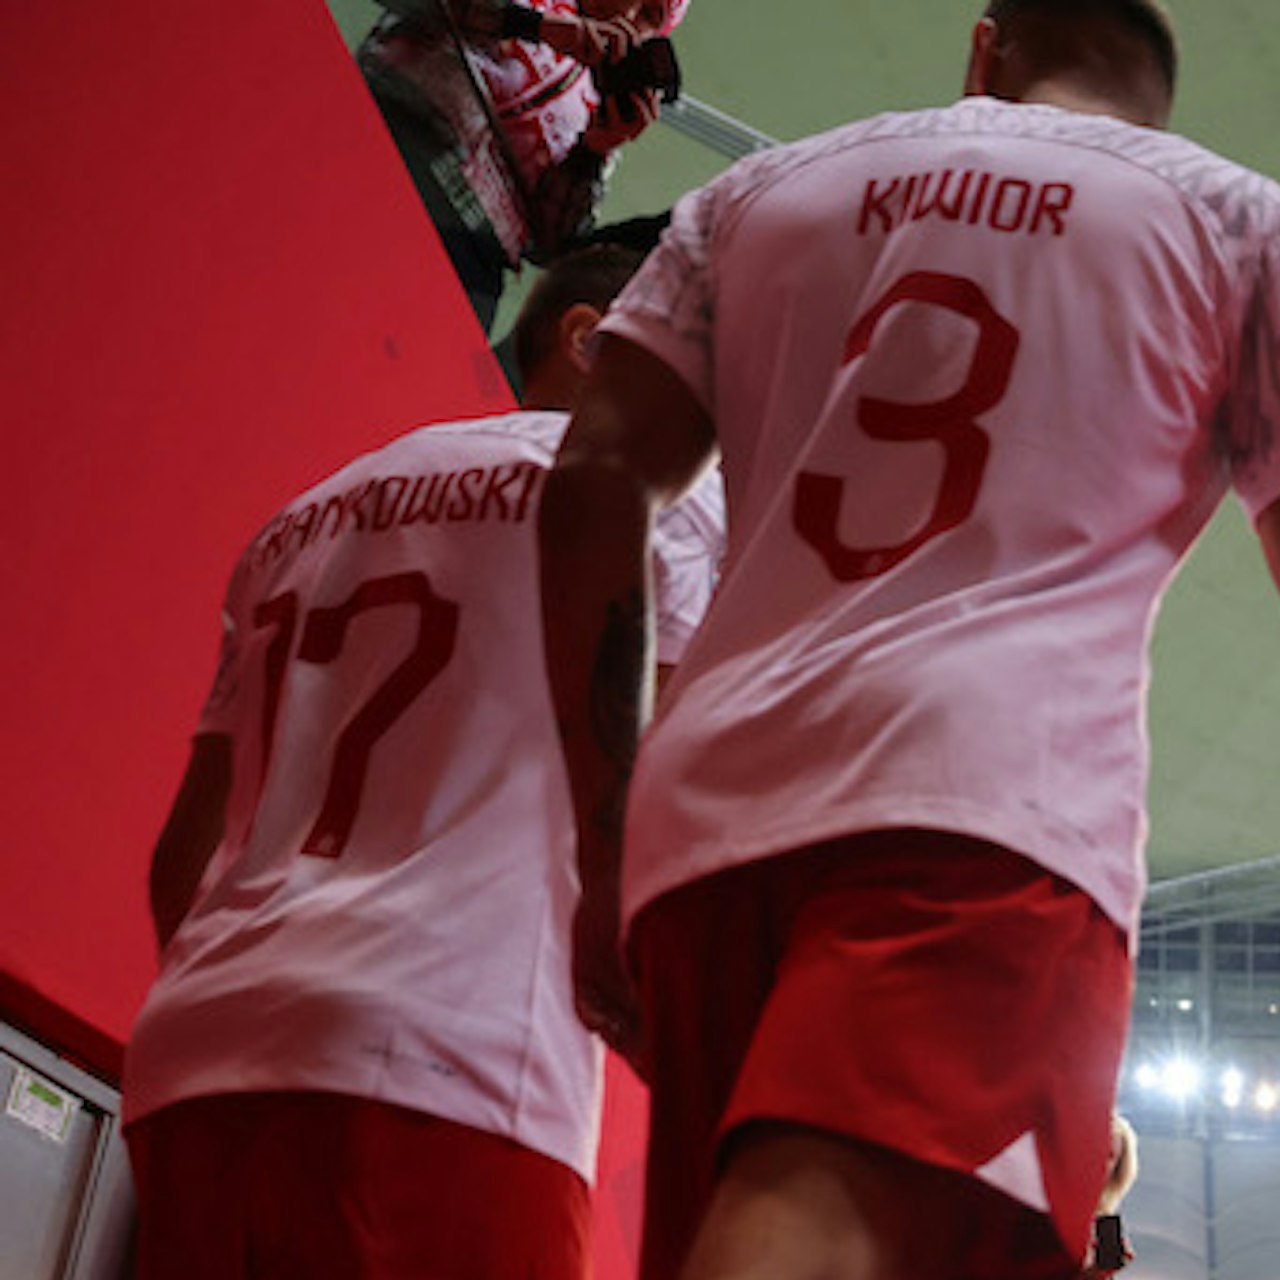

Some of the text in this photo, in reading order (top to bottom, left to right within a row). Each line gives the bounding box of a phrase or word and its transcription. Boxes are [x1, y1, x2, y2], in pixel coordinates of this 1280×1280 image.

[857, 169, 1074, 236] KIWIOR
[792, 270, 1020, 583] 3
[245, 570, 460, 858] 17
